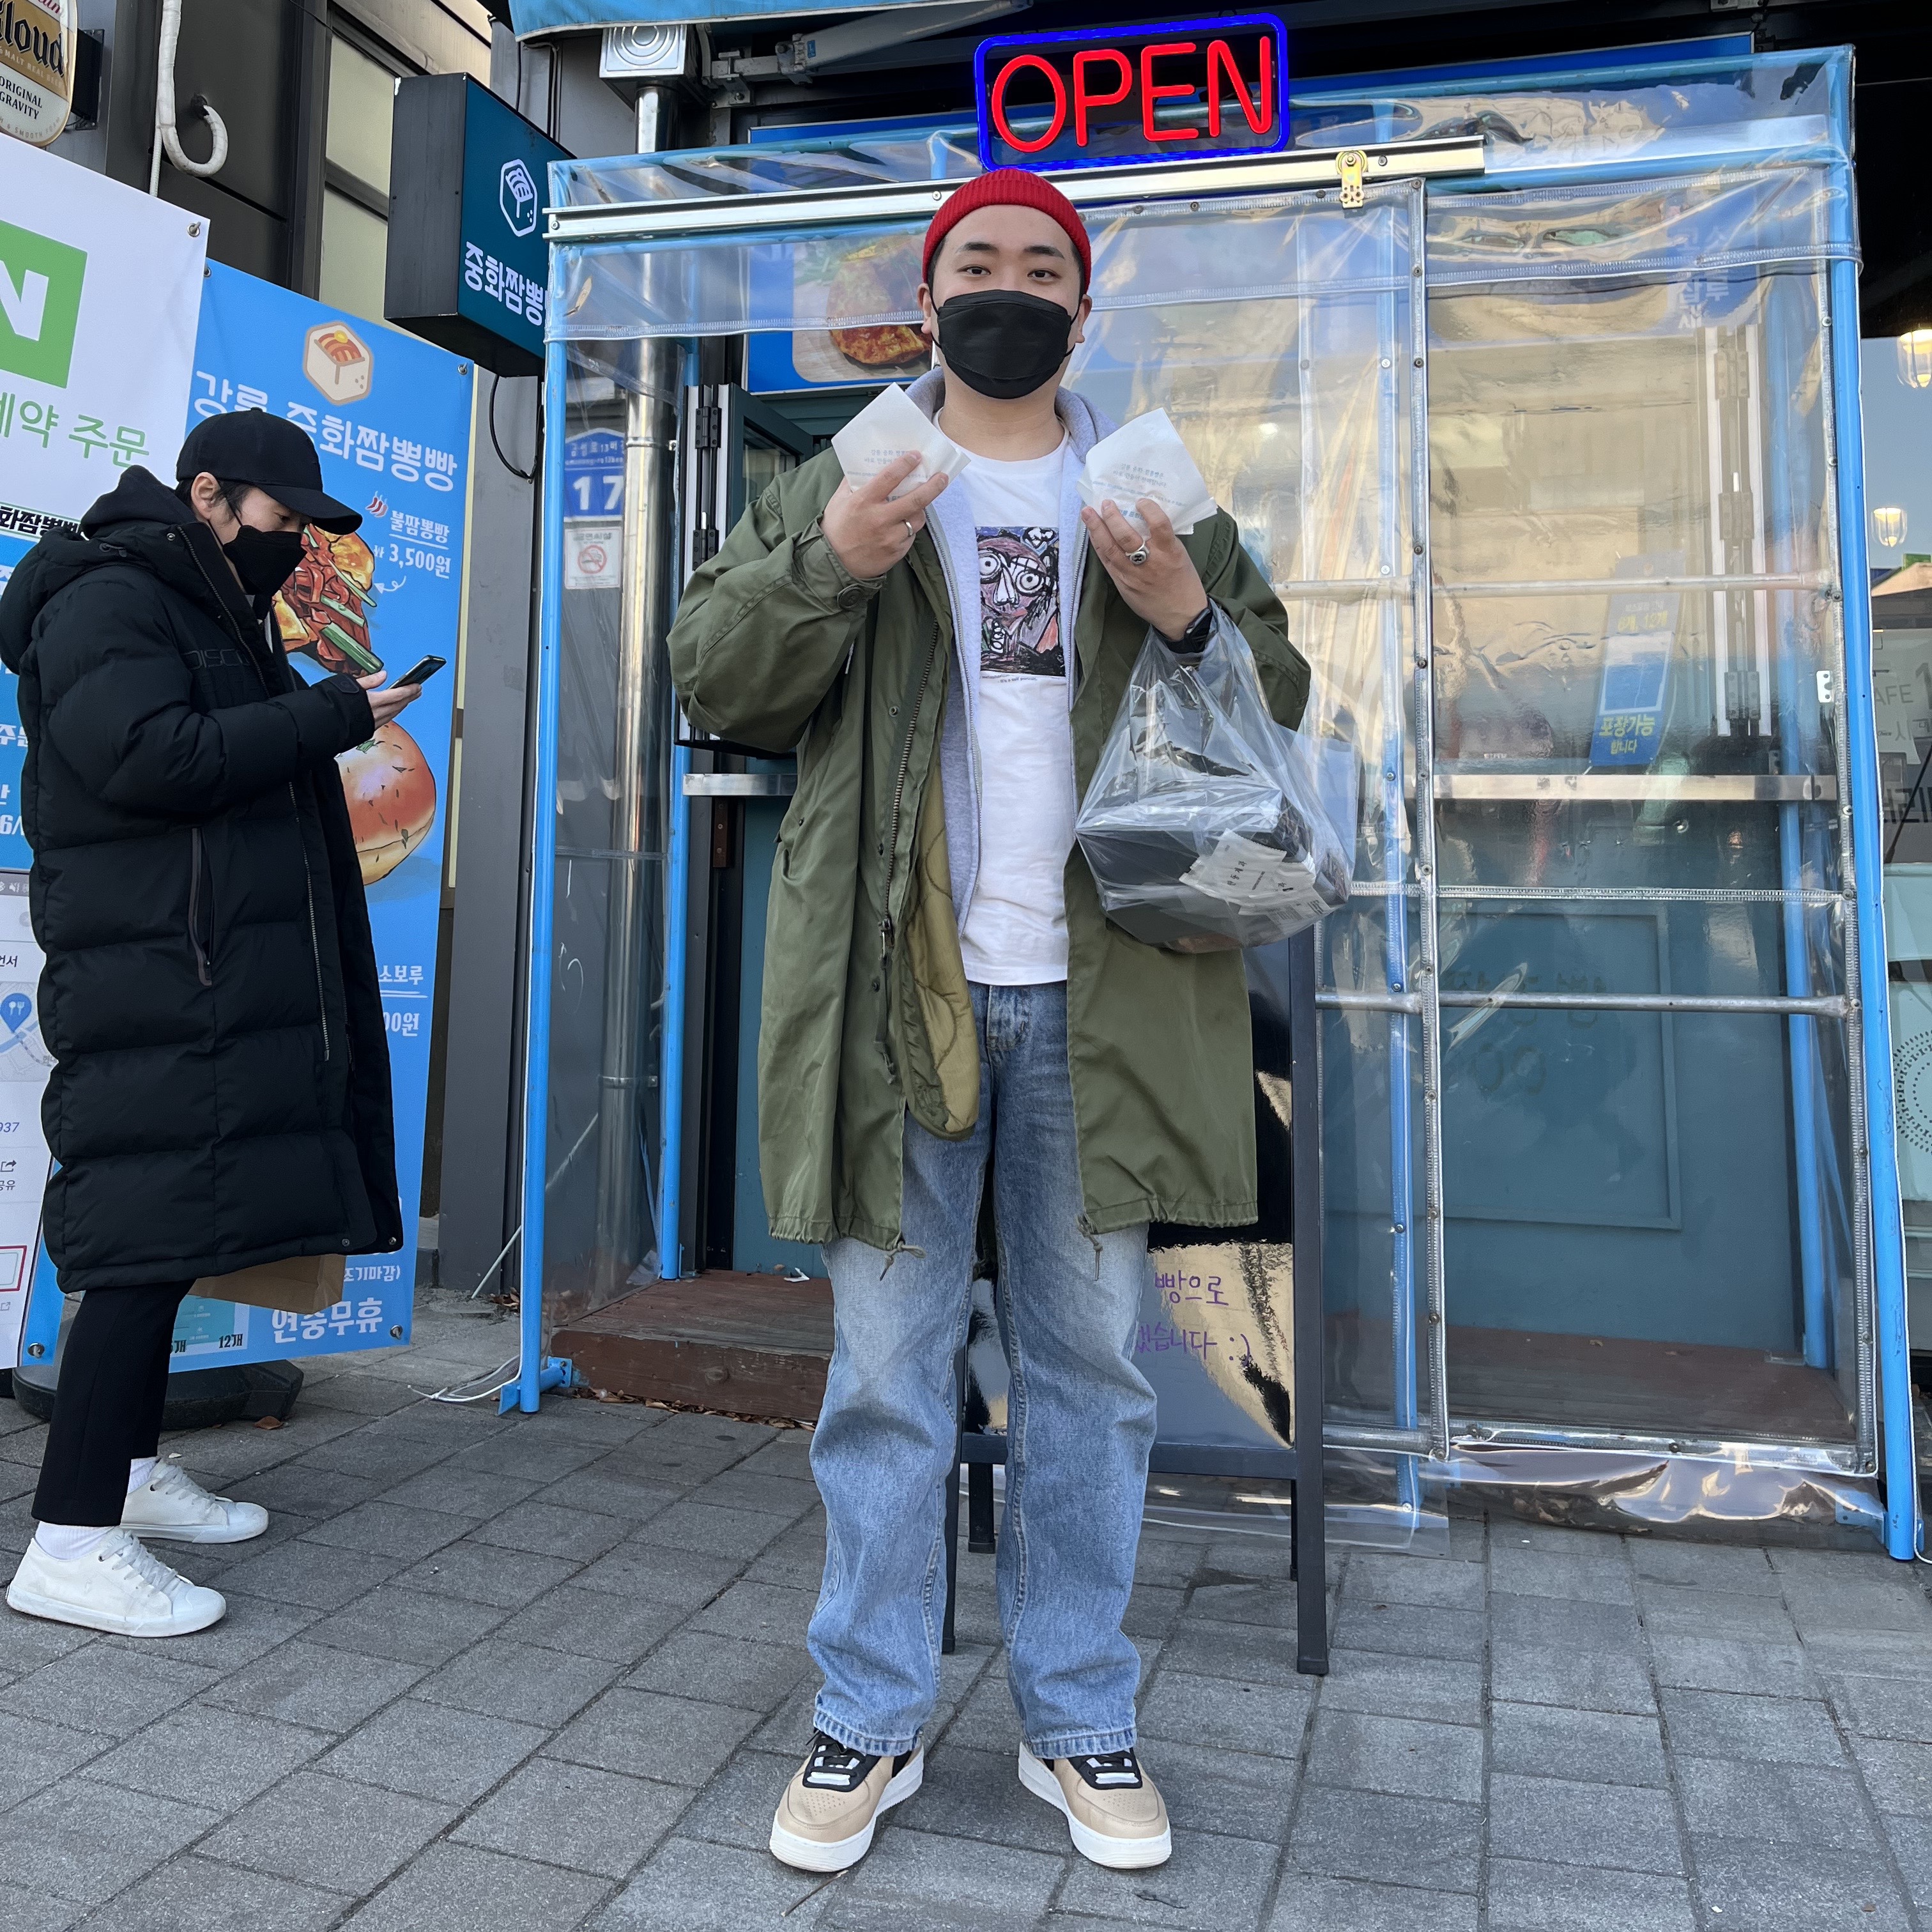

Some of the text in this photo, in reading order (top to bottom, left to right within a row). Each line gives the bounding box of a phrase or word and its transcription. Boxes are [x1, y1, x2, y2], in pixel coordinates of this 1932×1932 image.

[0, 0, 65, 78] loud
[4, 49, 24, 66] MALT
[27, 63, 44, 78] REAL
[0, 75, 43, 108] ORIGINAL
[0, 91, 40, 120] GRAVITY
[992, 36, 1272, 153] OPEN
[15, 126, 43, 139] SMOOTH
[464, 241, 548, 326] 중화짬뽕
[68, 414, 150, 468] 주문
[573, 475, 624, 510] 17
[390, 510, 450, 544] 불짬뽕빵
[388, 543, 451, 579] 3,500원
[1599, 714, 1656, 737] 포장가능
[1154, 1269, 1229, 1306] 빵으로
[272, 1297, 383, 1344] 연중무휴
[218, 1333, 243, 1349] 12개
